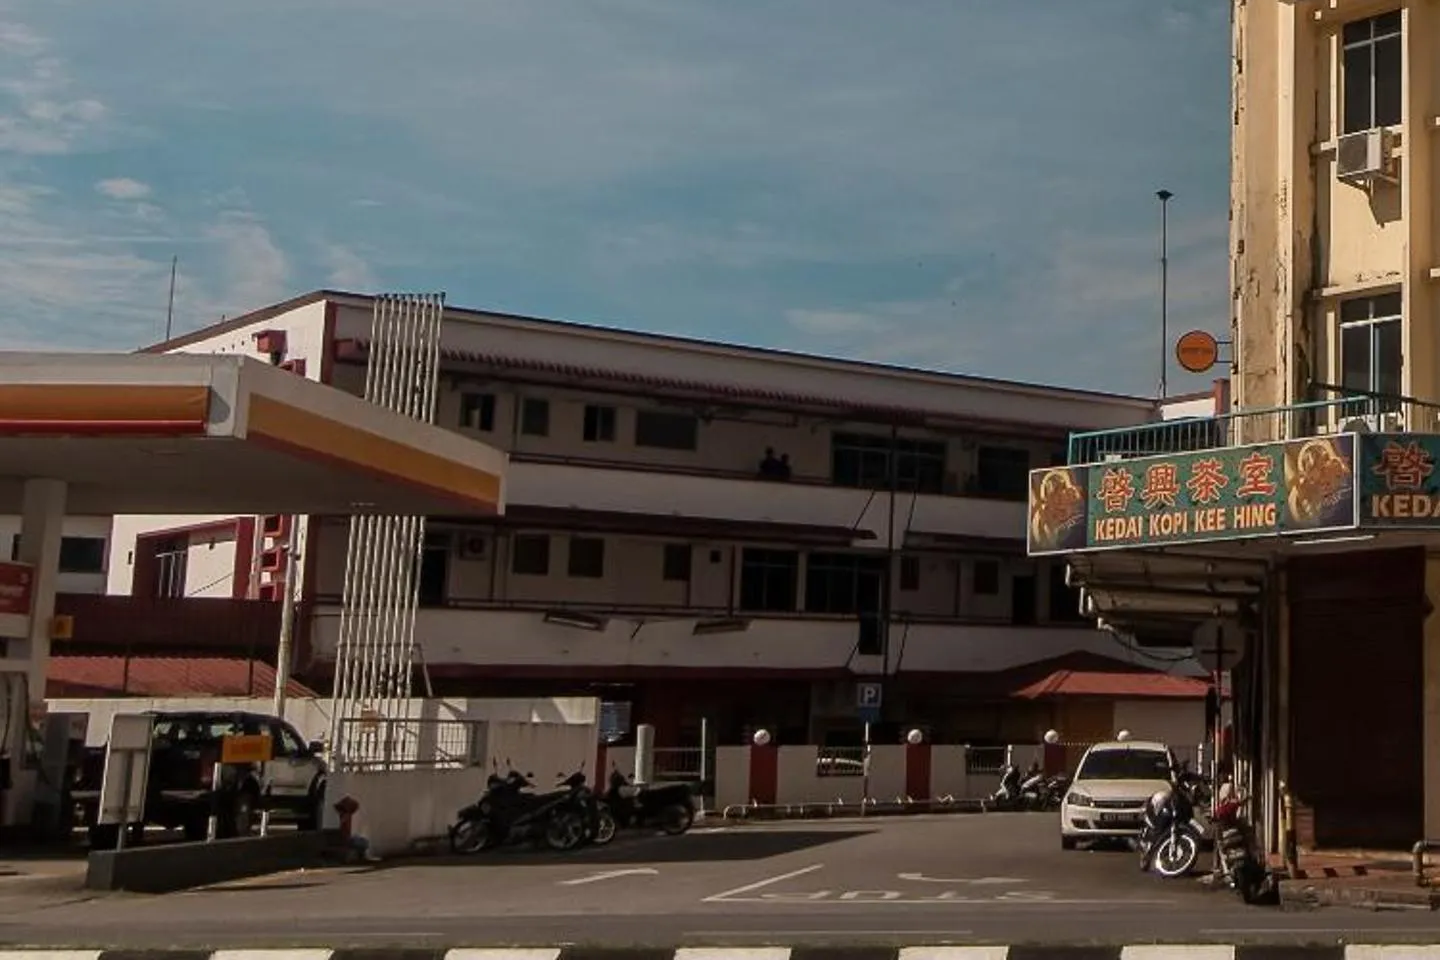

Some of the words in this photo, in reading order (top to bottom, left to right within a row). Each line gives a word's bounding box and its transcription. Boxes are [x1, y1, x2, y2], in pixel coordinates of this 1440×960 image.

[1094, 515, 1142, 542] KEDAI
[1149, 511, 1188, 538] KOPI
[1194, 506, 1225, 531] KEE
[1233, 502, 1277, 529] HING
[864, 686, 876, 704] P
